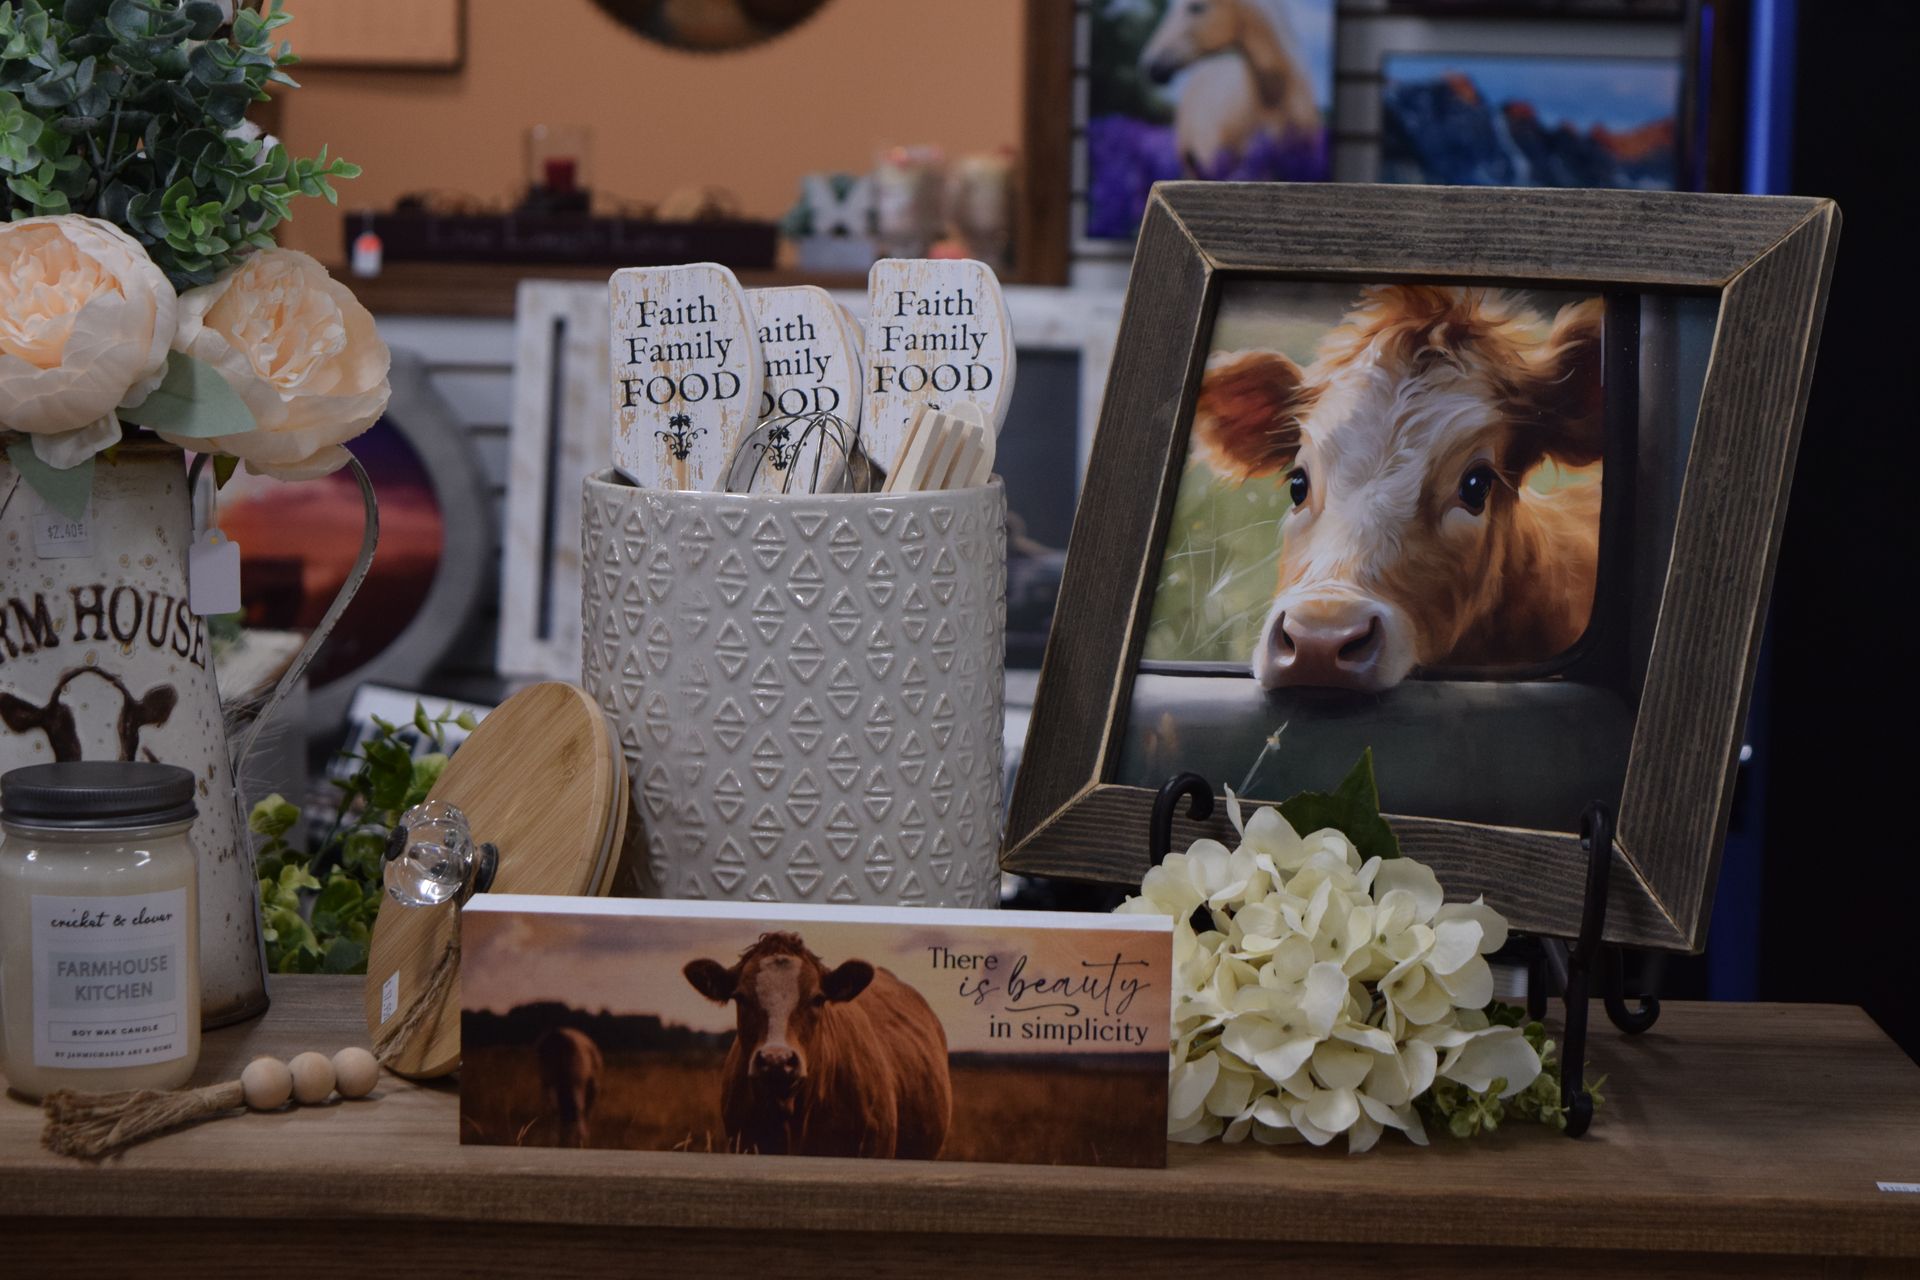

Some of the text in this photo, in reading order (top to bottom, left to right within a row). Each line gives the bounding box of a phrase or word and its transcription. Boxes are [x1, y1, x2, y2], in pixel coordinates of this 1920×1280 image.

[635, 295, 718, 328] Faith
[893, 288, 975, 317] Faith
[758, 314, 817, 344] aith
[881, 323, 988, 360] Family
[625, 331, 733, 367] Family
[765, 348, 832, 383] mily
[873, 364, 993, 393] FOOD
[619, 371, 741, 408] FOOD
[0, 584, 206, 670] RM HOUSE
[51, 906, 173, 928] cricket & clover
[57, 955, 168, 978] FARMHOUSE
[928, 946, 998, 969] There
[75, 981, 153, 1001] KITCHEN
[959, 952, 1151, 1017] is beauty
[71, 1024, 159, 1038] SOY WAX CANDLE
[989, 1014, 1149, 1046] in simplicity
